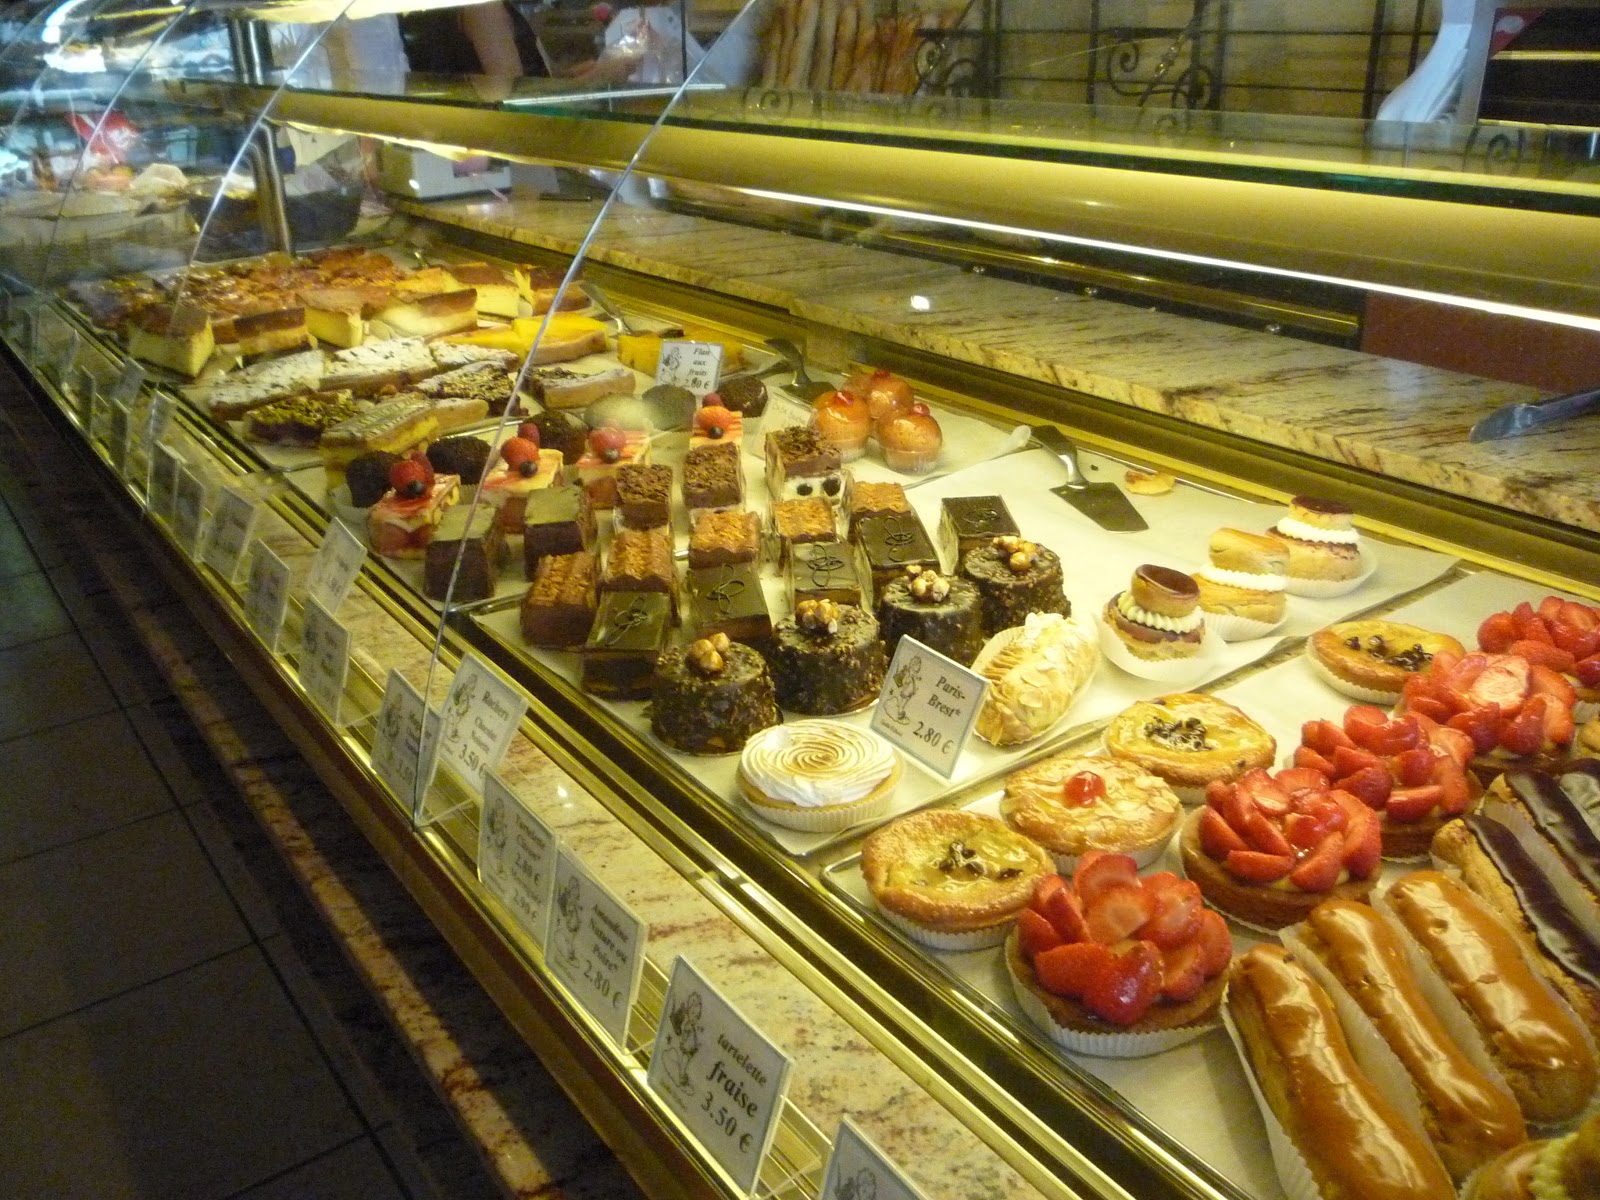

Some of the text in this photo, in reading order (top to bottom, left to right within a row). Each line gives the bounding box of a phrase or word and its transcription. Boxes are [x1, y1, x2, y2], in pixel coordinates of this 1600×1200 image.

[935, 676, 966, 700] Paris-
[912, 721, 942, 747] 2.80
[942, 739, 954, 754] €
[583, 959, 610, 997] 2.80
[716, 1032, 768, 1087] tartelette
[705, 1059, 759, 1118] fraise
[701, 1091, 754, 1154] 3.50 €
